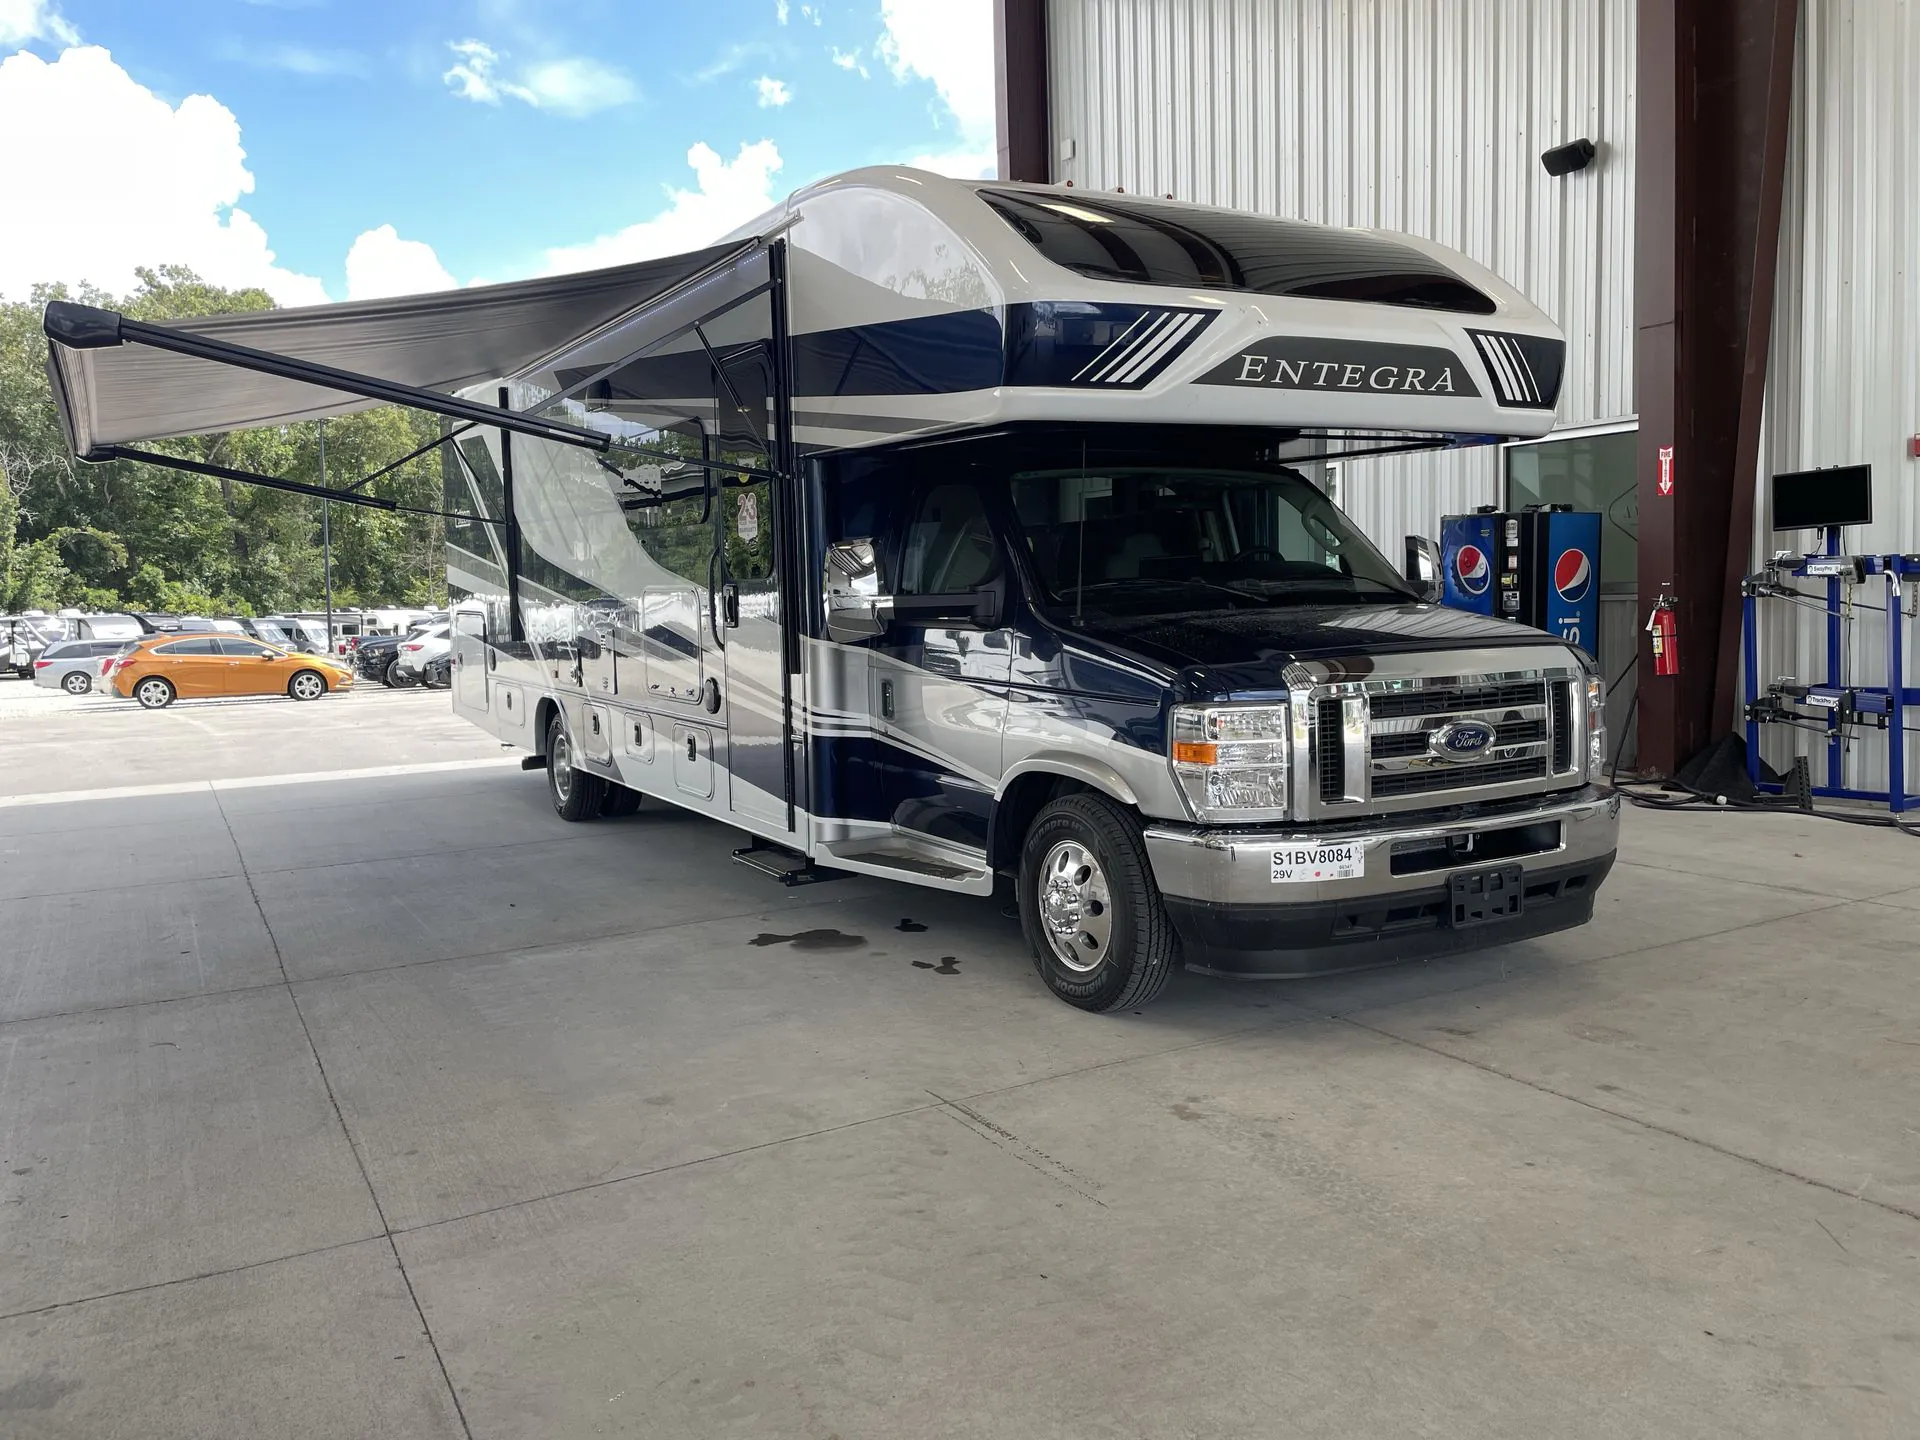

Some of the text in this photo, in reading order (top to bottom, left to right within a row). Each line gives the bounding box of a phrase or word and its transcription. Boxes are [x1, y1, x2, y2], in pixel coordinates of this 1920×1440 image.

[1235, 354, 1455, 392] ENTEGRA
[1660, 450, 1672, 458] FIRE
[1455, 730, 1483, 748] Ford
[1273, 848, 1352, 866] S1BV8084
[1273, 869, 1293, 879] 29V
